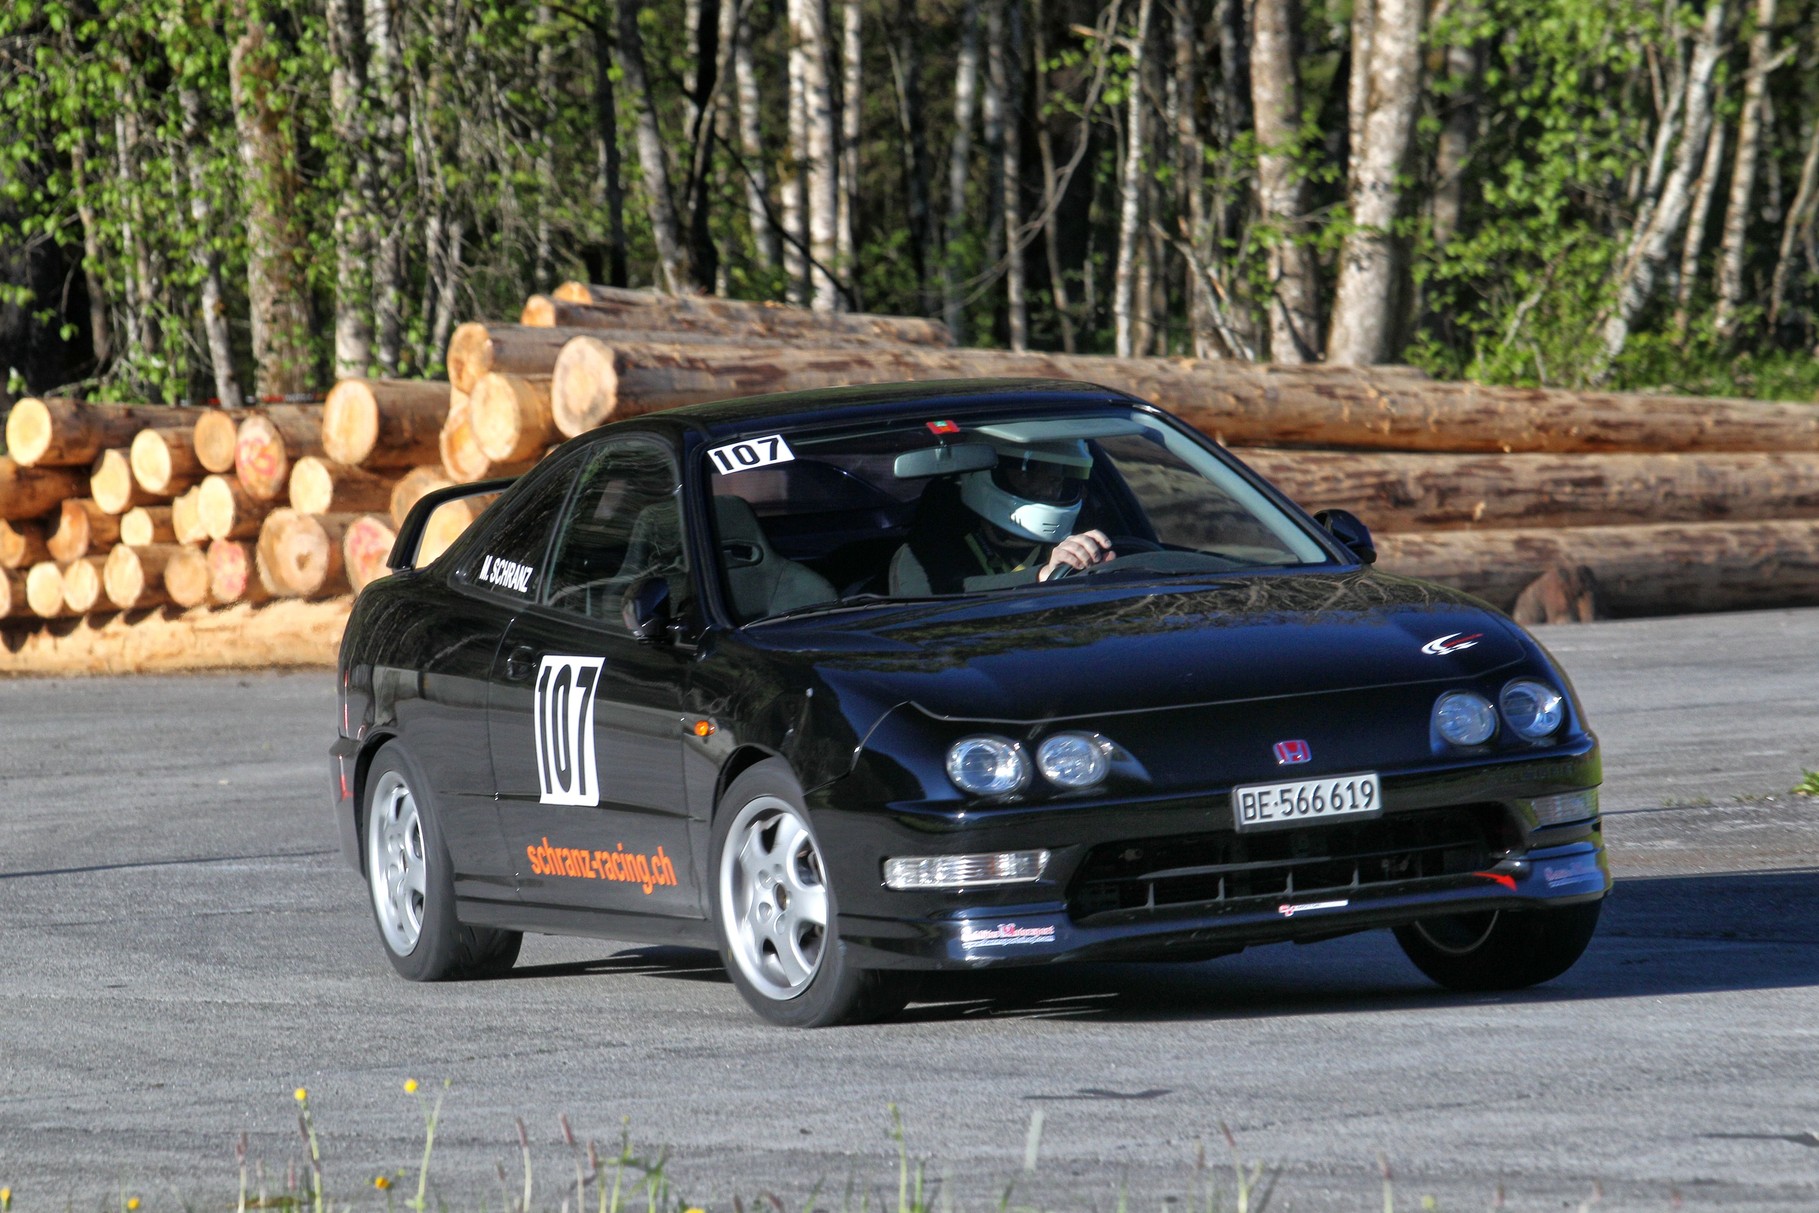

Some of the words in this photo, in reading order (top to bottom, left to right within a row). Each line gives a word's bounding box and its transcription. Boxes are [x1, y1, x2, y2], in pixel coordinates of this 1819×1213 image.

[713, 436, 780, 472] 107
[479, 555, 494, 581] M.
[490, 557, 534, 594] SCHRANZ
[537, 663, 600, 796] 107
[526, 836, 678, 895] schranz-racing.ch
